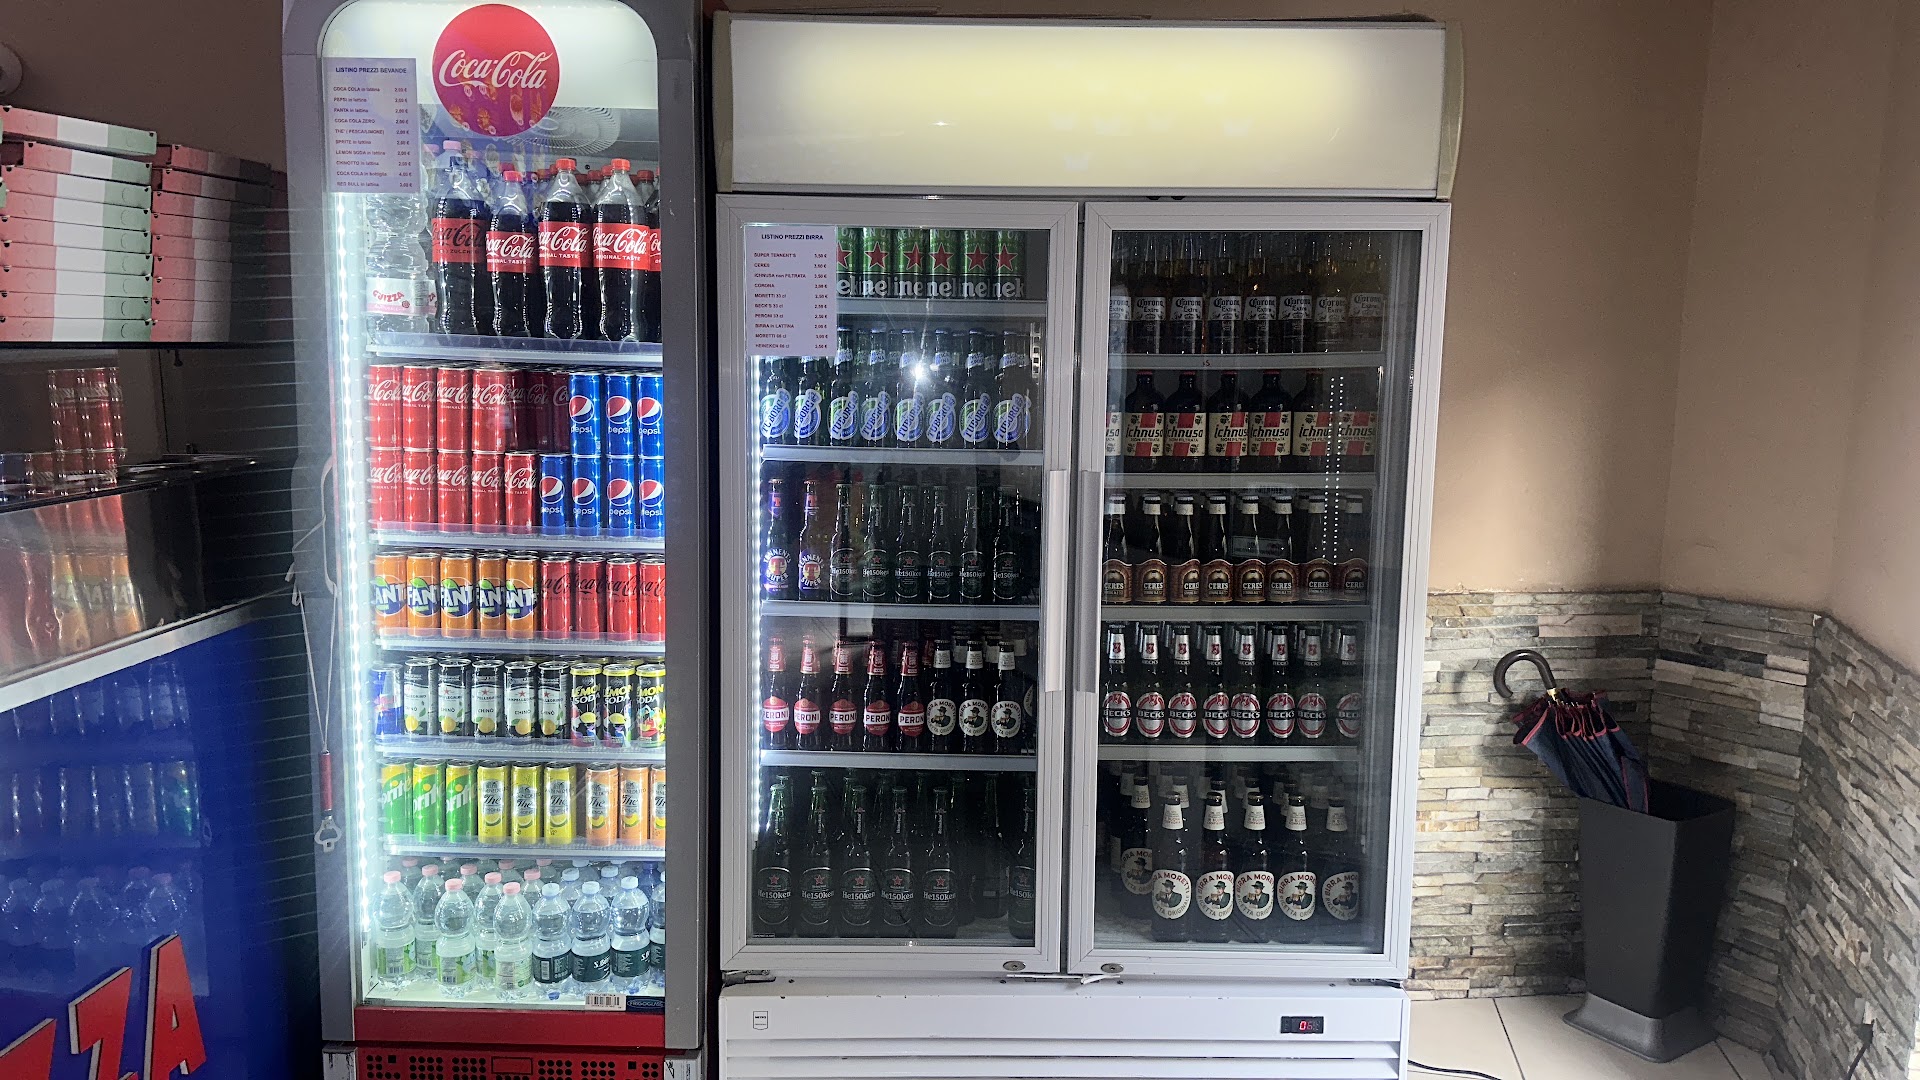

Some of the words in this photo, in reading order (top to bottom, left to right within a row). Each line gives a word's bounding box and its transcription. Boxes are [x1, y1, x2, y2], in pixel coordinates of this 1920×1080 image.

[439, 49, 553, 88] Coca-Cola
[1137, 298, 1164, 308] Corona
[1176, 298, 1202, 308] Corona
[1213, 298, 1241, 307] Corona
[1248, 298, 1276, 308] Corona
[1284, 297, 1311, 307] Corona
[1353, 294, 1381, 303] Corona
[761, 399, 785, 433] TUBORG
[831, 401, 856, 435] TUBORG
[861, 401, 884, 435] TUBORG
[897, 404, 921, 437] TUBORG
[927, 403, 951, 437] TUBORG
[964, 403, 988, 437] TUBORG
[996, 405, 1020, 439] TUBORG
[1214, 425, 1247, 438] ichnus
[766, 573, 789, 582] SUPER
[800, 577, 822, 587] SUPER
[1143, 582, 1163, 590] CERES
[1208, 582, 1229, 590] CERES
[830, 711, 857, 722] PERONI
[1163, 872, 1190, 894] MORETTI
[1197, 875, 1215, 894] BIRRA
[1236, 874, 1252, 893] BIRRA
[1278, 875, 1296, 894] BIRRA
[1325, 877, 1343, 896] BIRRA
